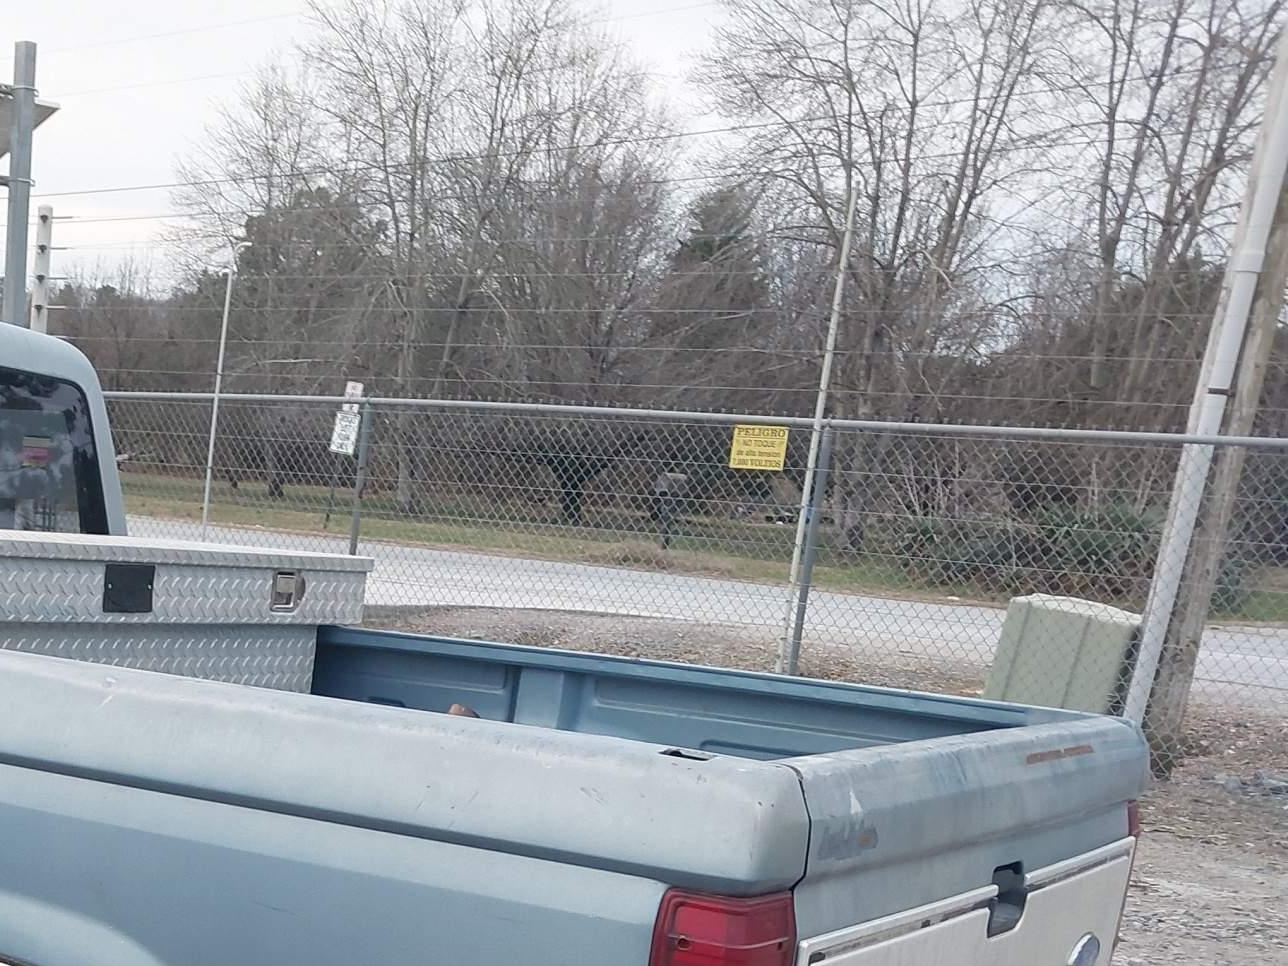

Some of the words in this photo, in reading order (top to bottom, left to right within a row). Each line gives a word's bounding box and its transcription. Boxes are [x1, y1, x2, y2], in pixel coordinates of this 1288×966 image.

[737, 427, 786, 438] PELIGRO
[743, 439, 753, 447] NO
[754, 440, 777, 448] TOQUE
